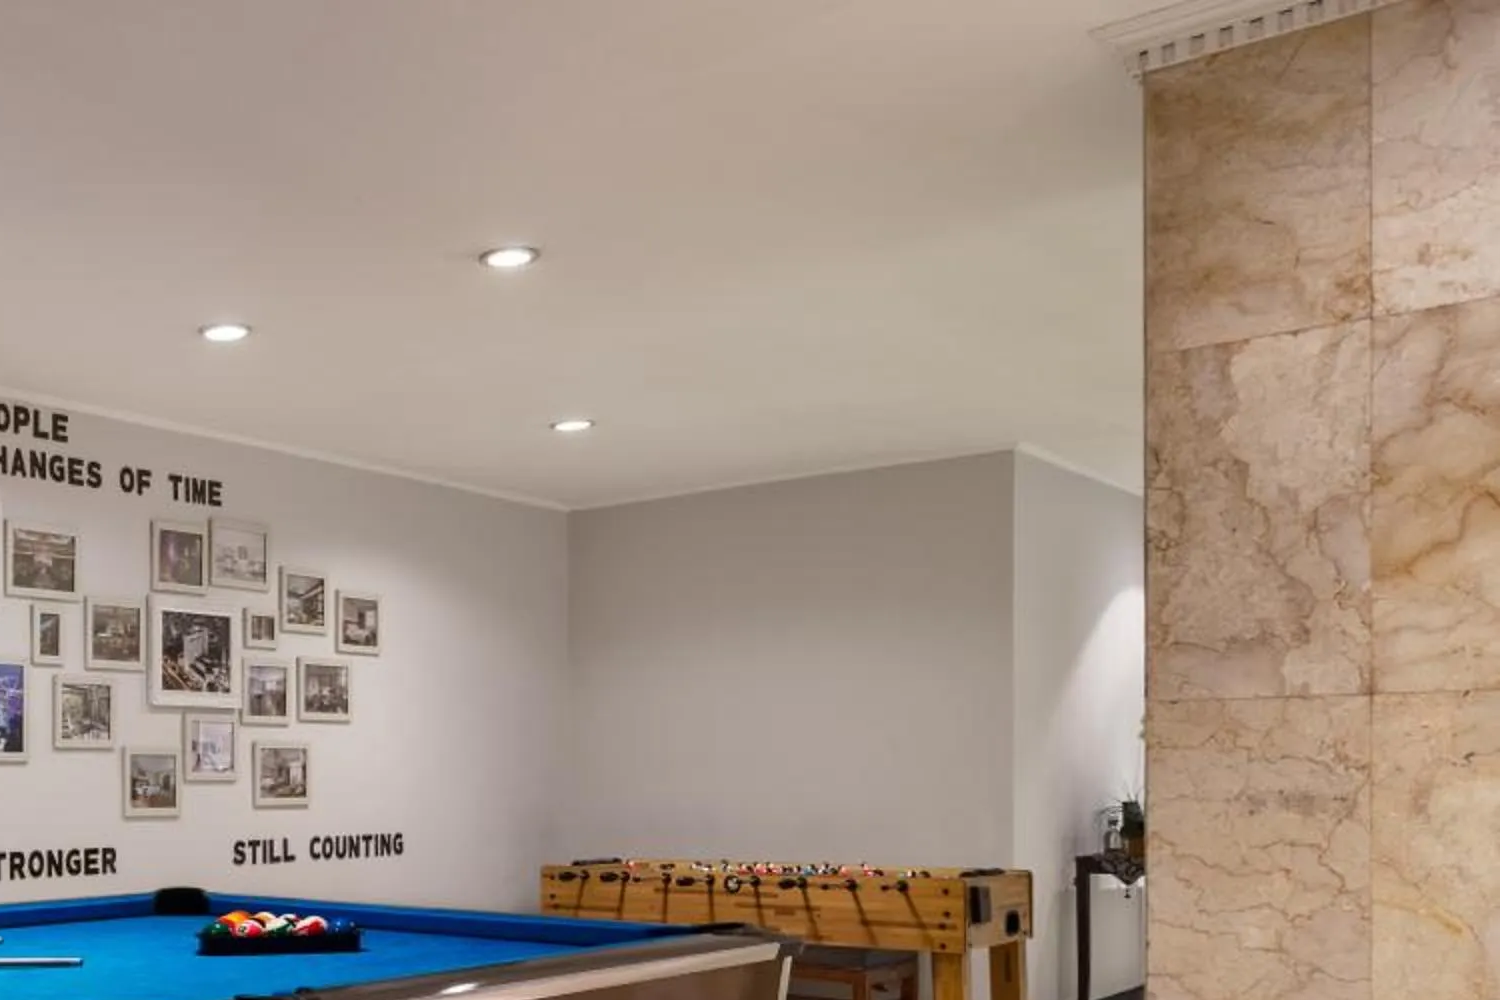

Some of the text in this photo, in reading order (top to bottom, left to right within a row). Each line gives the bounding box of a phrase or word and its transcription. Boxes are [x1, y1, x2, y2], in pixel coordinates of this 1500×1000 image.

[119, 467, 152, 496] OF
[168, 474, 222, 507] TIME
[233, 833, 404, 865] STILL COUNTING
